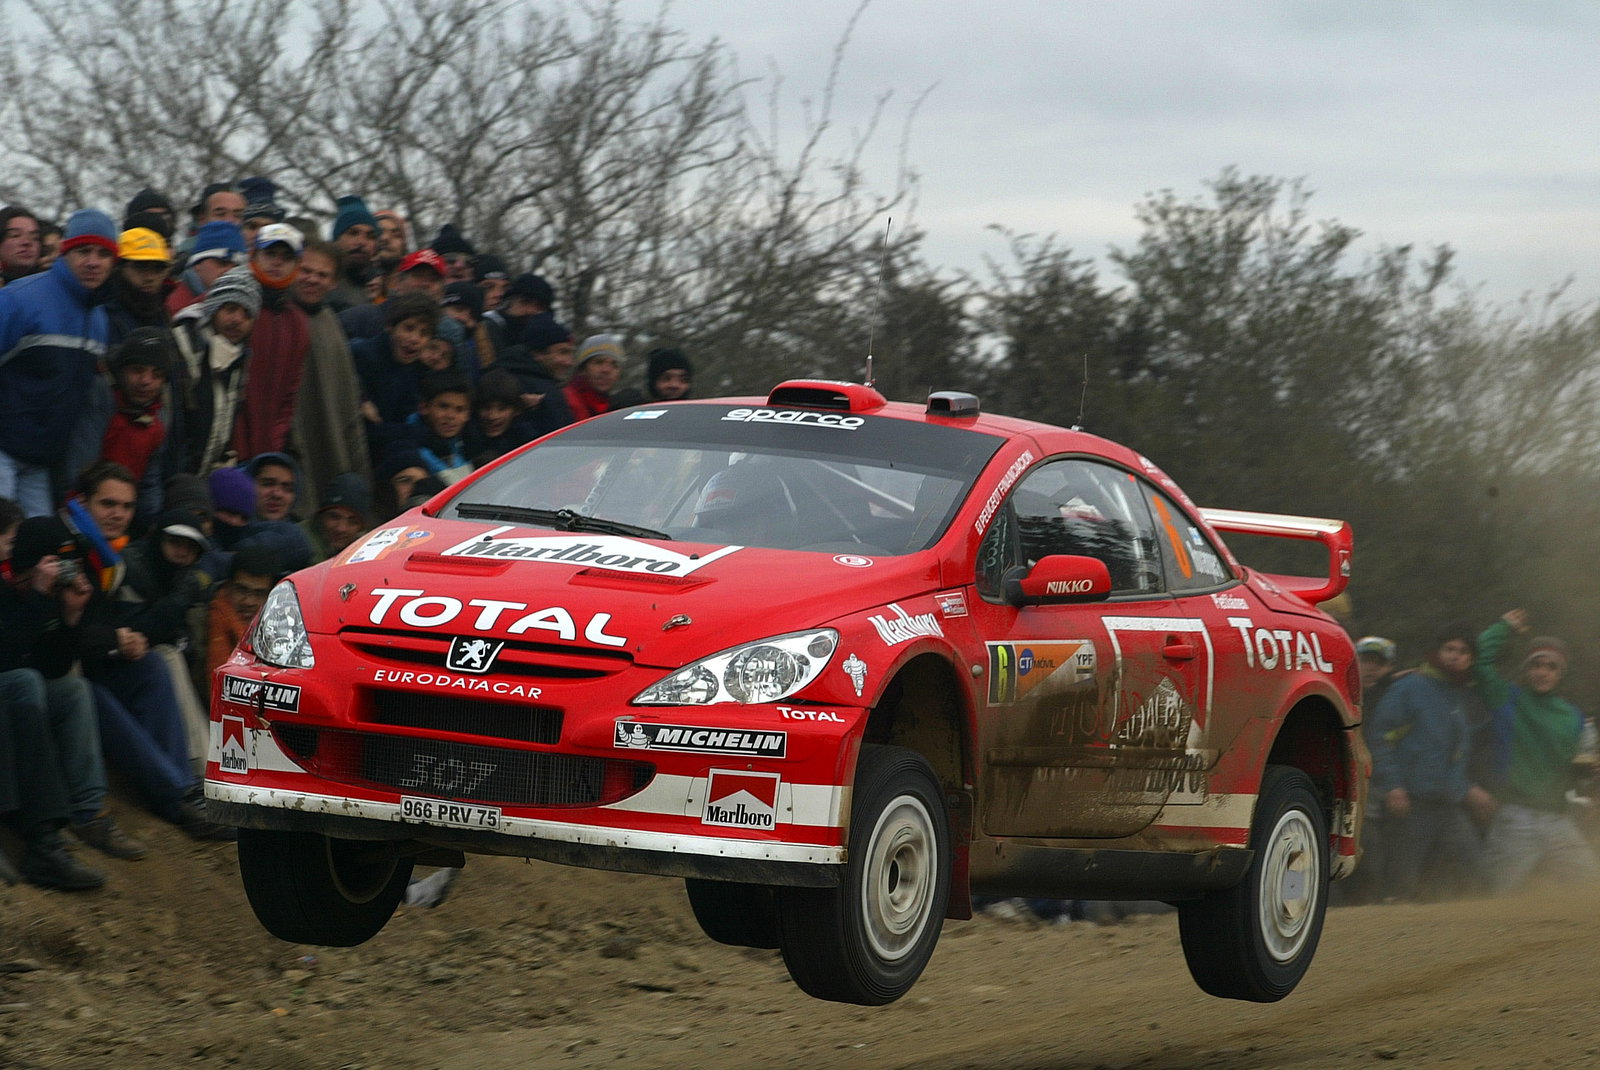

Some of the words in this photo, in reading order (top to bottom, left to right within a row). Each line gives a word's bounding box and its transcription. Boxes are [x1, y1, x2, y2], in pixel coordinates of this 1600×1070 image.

[452, 541, 681, 573] Marlboro
[1046, 579, 1093, 594] NIKKO
[369, 588, 628, 647] TOTAL
[867, 602, 944, 647] Marlboro
[1227, 617, 1334, 673] TOTAL
[1076, 654, 1094, 666] YPF
[231, 680, 297, 704] MICHLIN
[374, 669, 542, 699] EURODATACAR
[776, 702, 845, 723] TOTAL
[655, 728, 783, 750] MICHELIN
[221, 748, 247, 771] Marlboro
[404, 800, 433, 819] 966
[438, 804, 472, 824] PRV
[477, 809, 497, 827] 75
[706, 803, 773, 827] Marlboro
